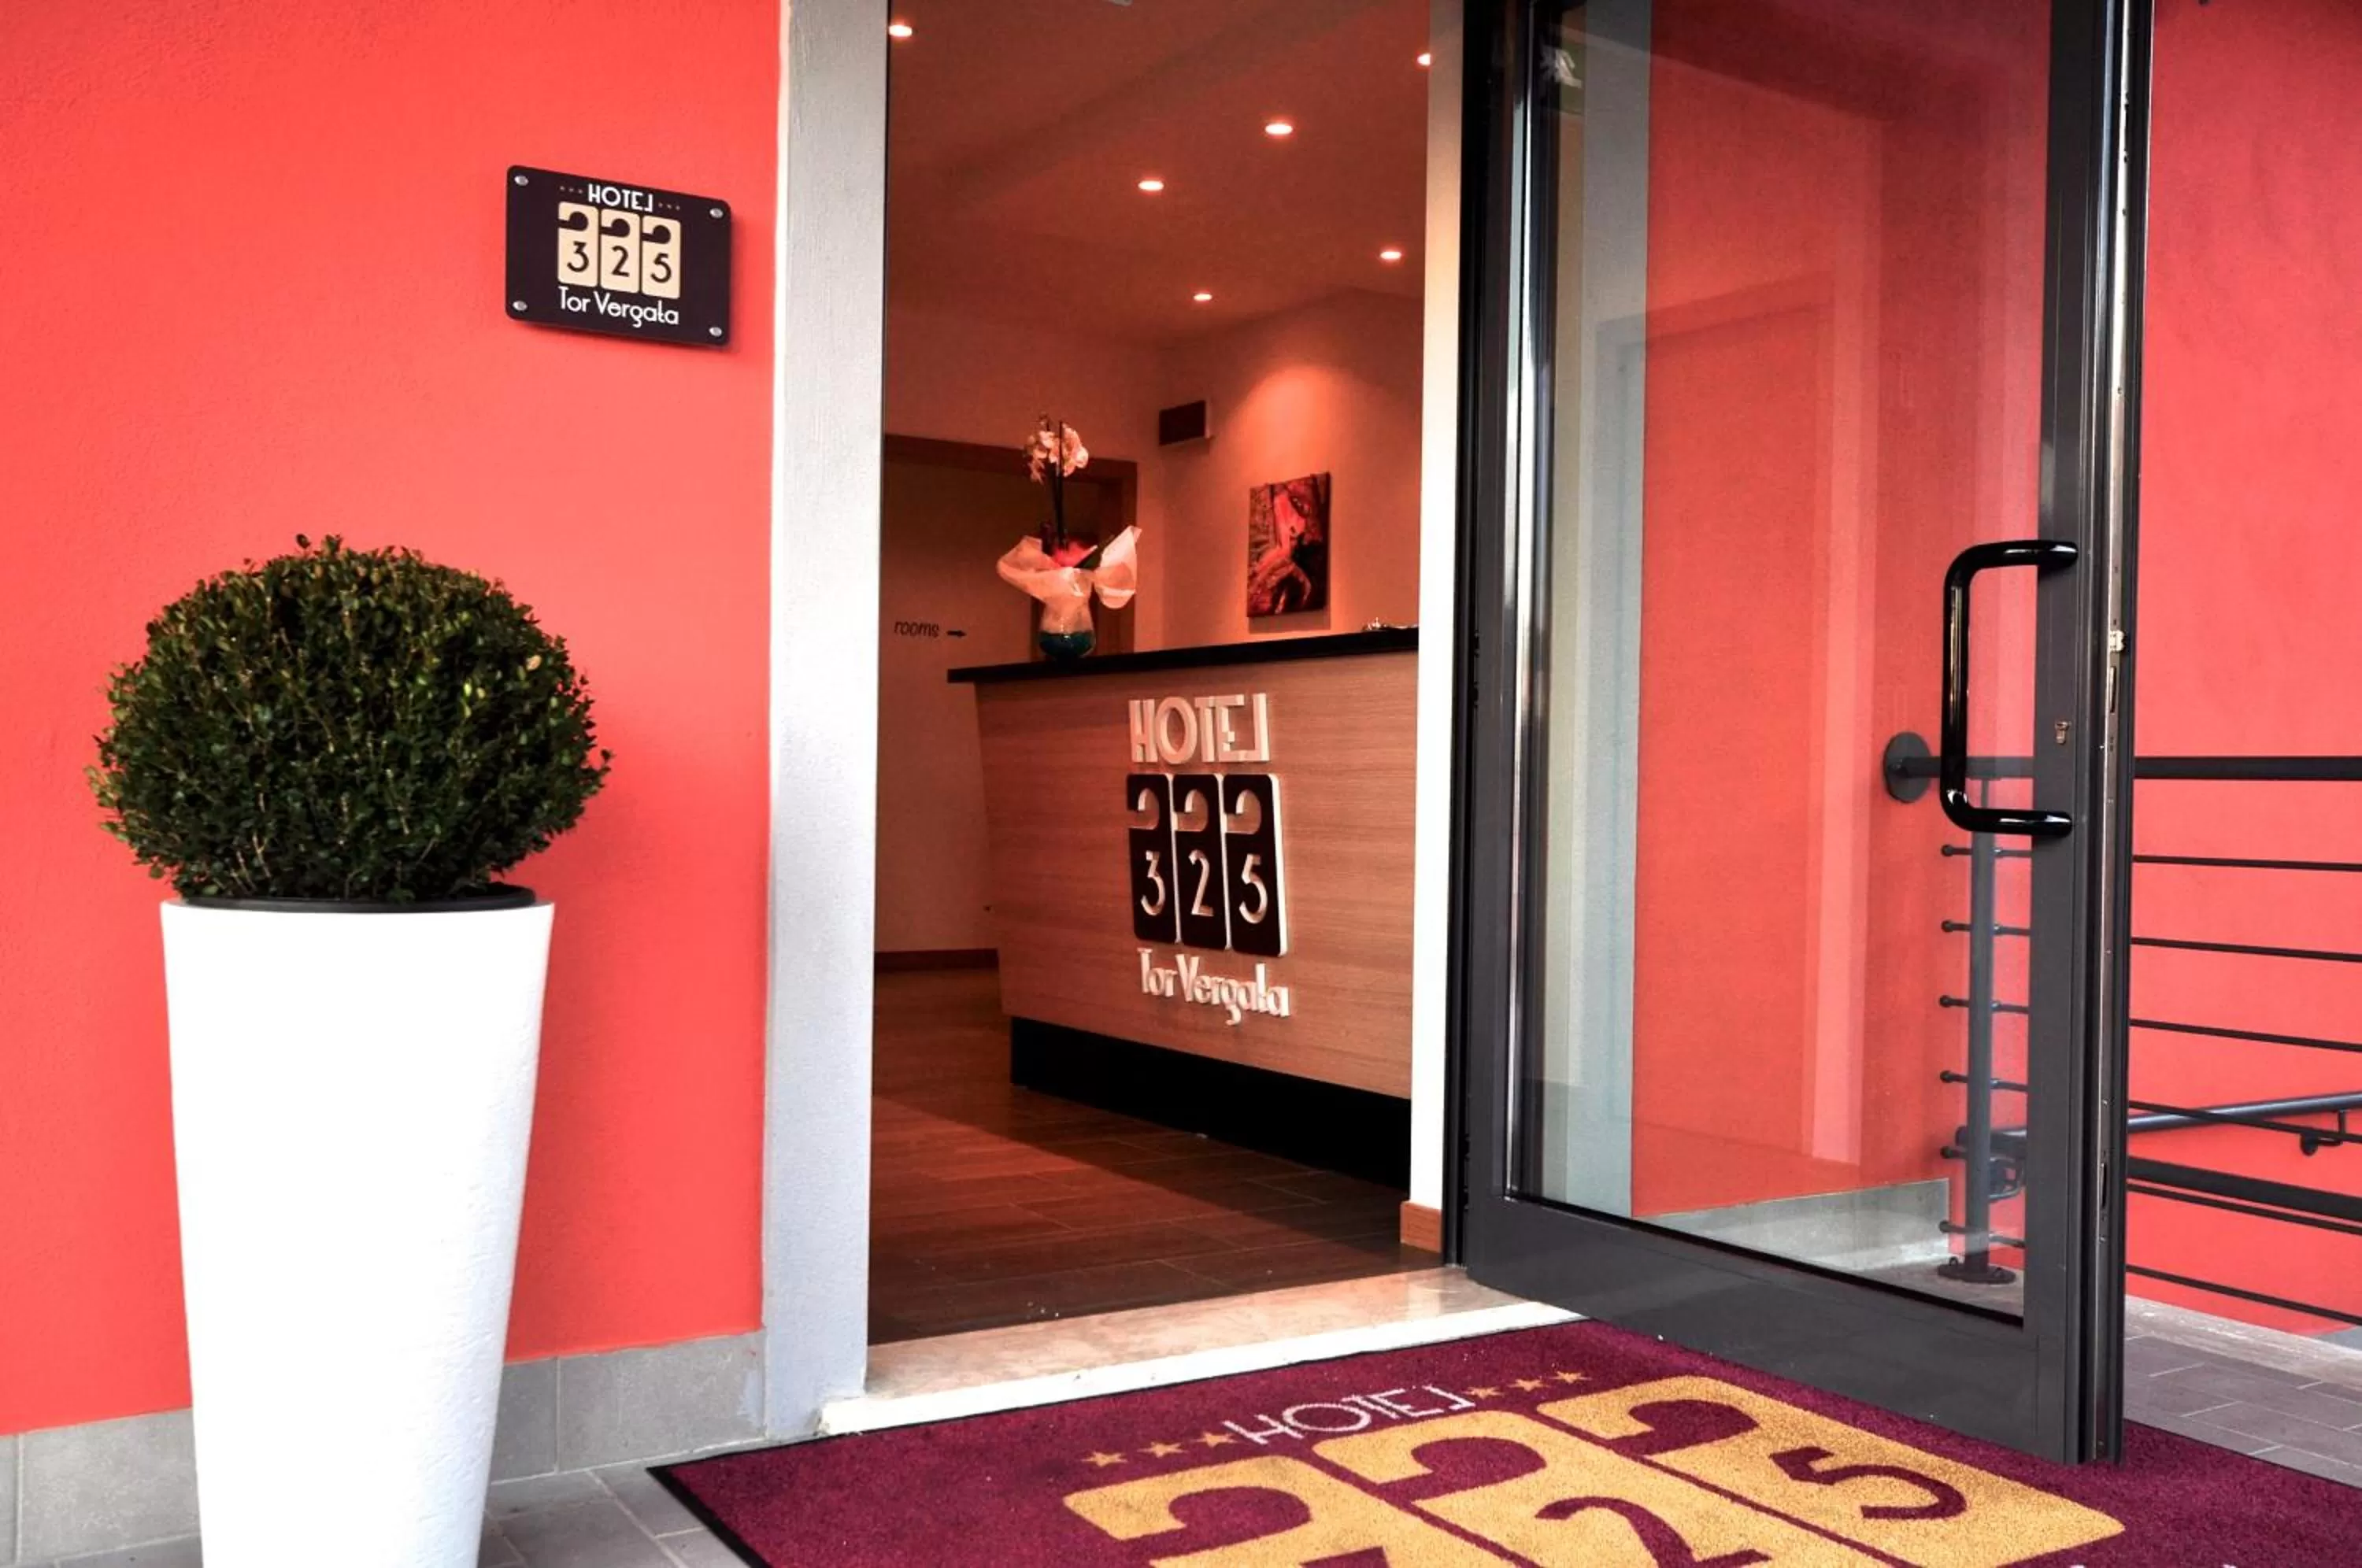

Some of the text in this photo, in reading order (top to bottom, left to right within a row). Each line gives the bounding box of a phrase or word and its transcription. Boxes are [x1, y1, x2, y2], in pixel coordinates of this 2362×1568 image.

[588, 183, 653, 213] HOTEL
[566, 240, 672, 283] 325
[558, 286, 679, 327] Tor Vergata
[894, 621, 939, 638] rooms
[1128, 693, 1270, 764] HOTEL
[1140, 849, 1268, 924] 325
[1137, 948, 1290, 1026] Tor Vergata
[1222, 1384, 1476, 1444] HOTEL
